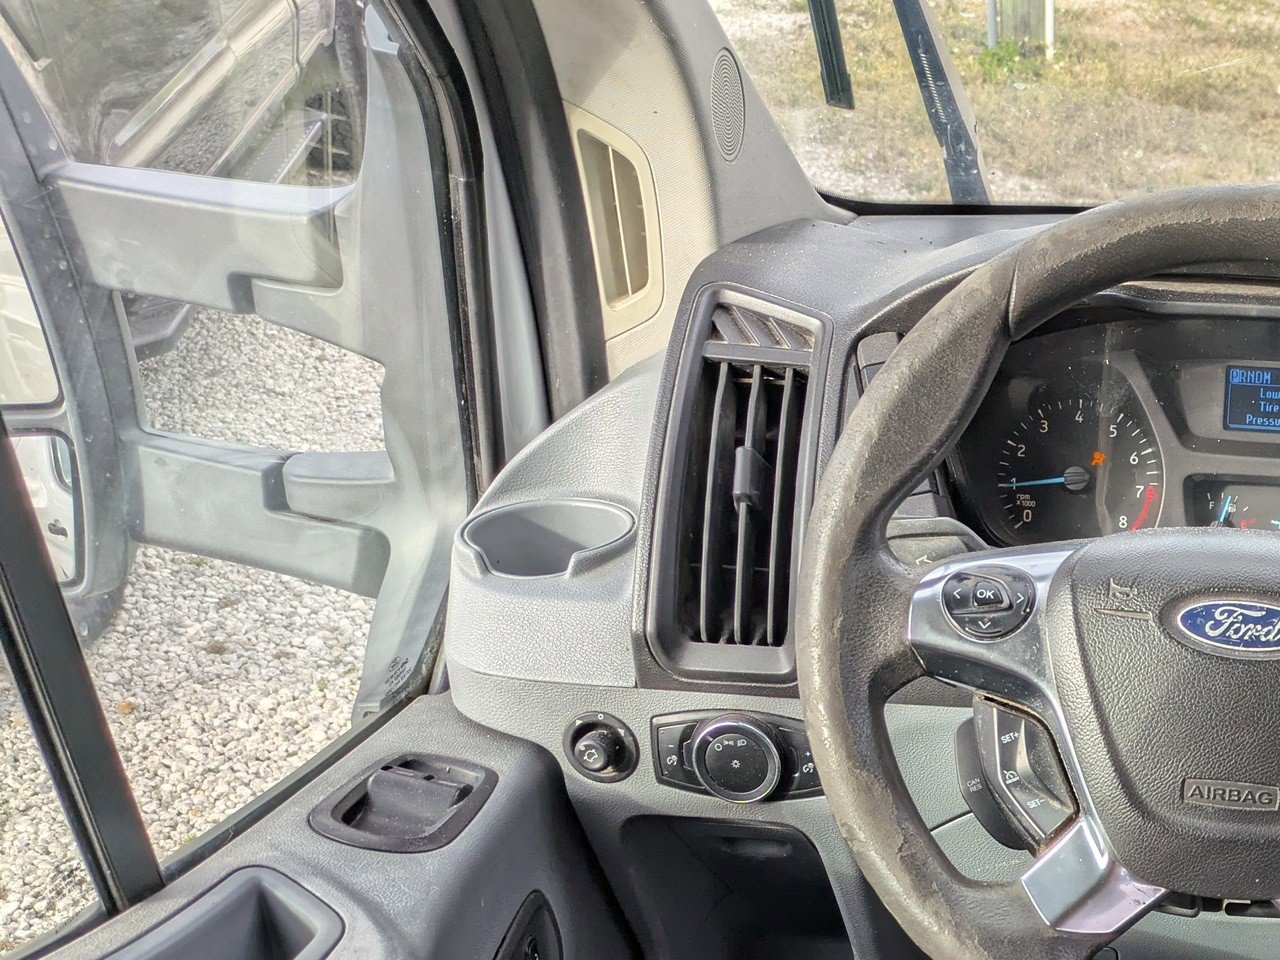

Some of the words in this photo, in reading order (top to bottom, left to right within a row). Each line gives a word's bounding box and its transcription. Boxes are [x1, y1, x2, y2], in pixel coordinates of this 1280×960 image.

[1230, 369, 1271, 384] PRNDM
[1260, 388, 1280, 399] Low
[1259, 401, 1280, 413] Tire
[1074, 411, 1084, 423] 4
[1039, 420, 1049, 433] 3
[1109, 424, 1118, 438] 5
[1017, 444, 1026, 457] 2
[1129, 452, 1139, 465] 6
[1010, 477, 1017, 490] 1
[1016, 493, 1031, 501] rpm
[1135, 486, 1145, 498] 7
[1209, 501, 1216, 510] F
[1023, 509, 1032, 522] 0
[1118, 515, 1128, 528] 8
[976, 589, 995, 599] OK
[1000, 731, 1020, 744] SET+
[1188, 785, 1274, 806] AIRBAG
[1026, 799, 1045, 809] SET-
